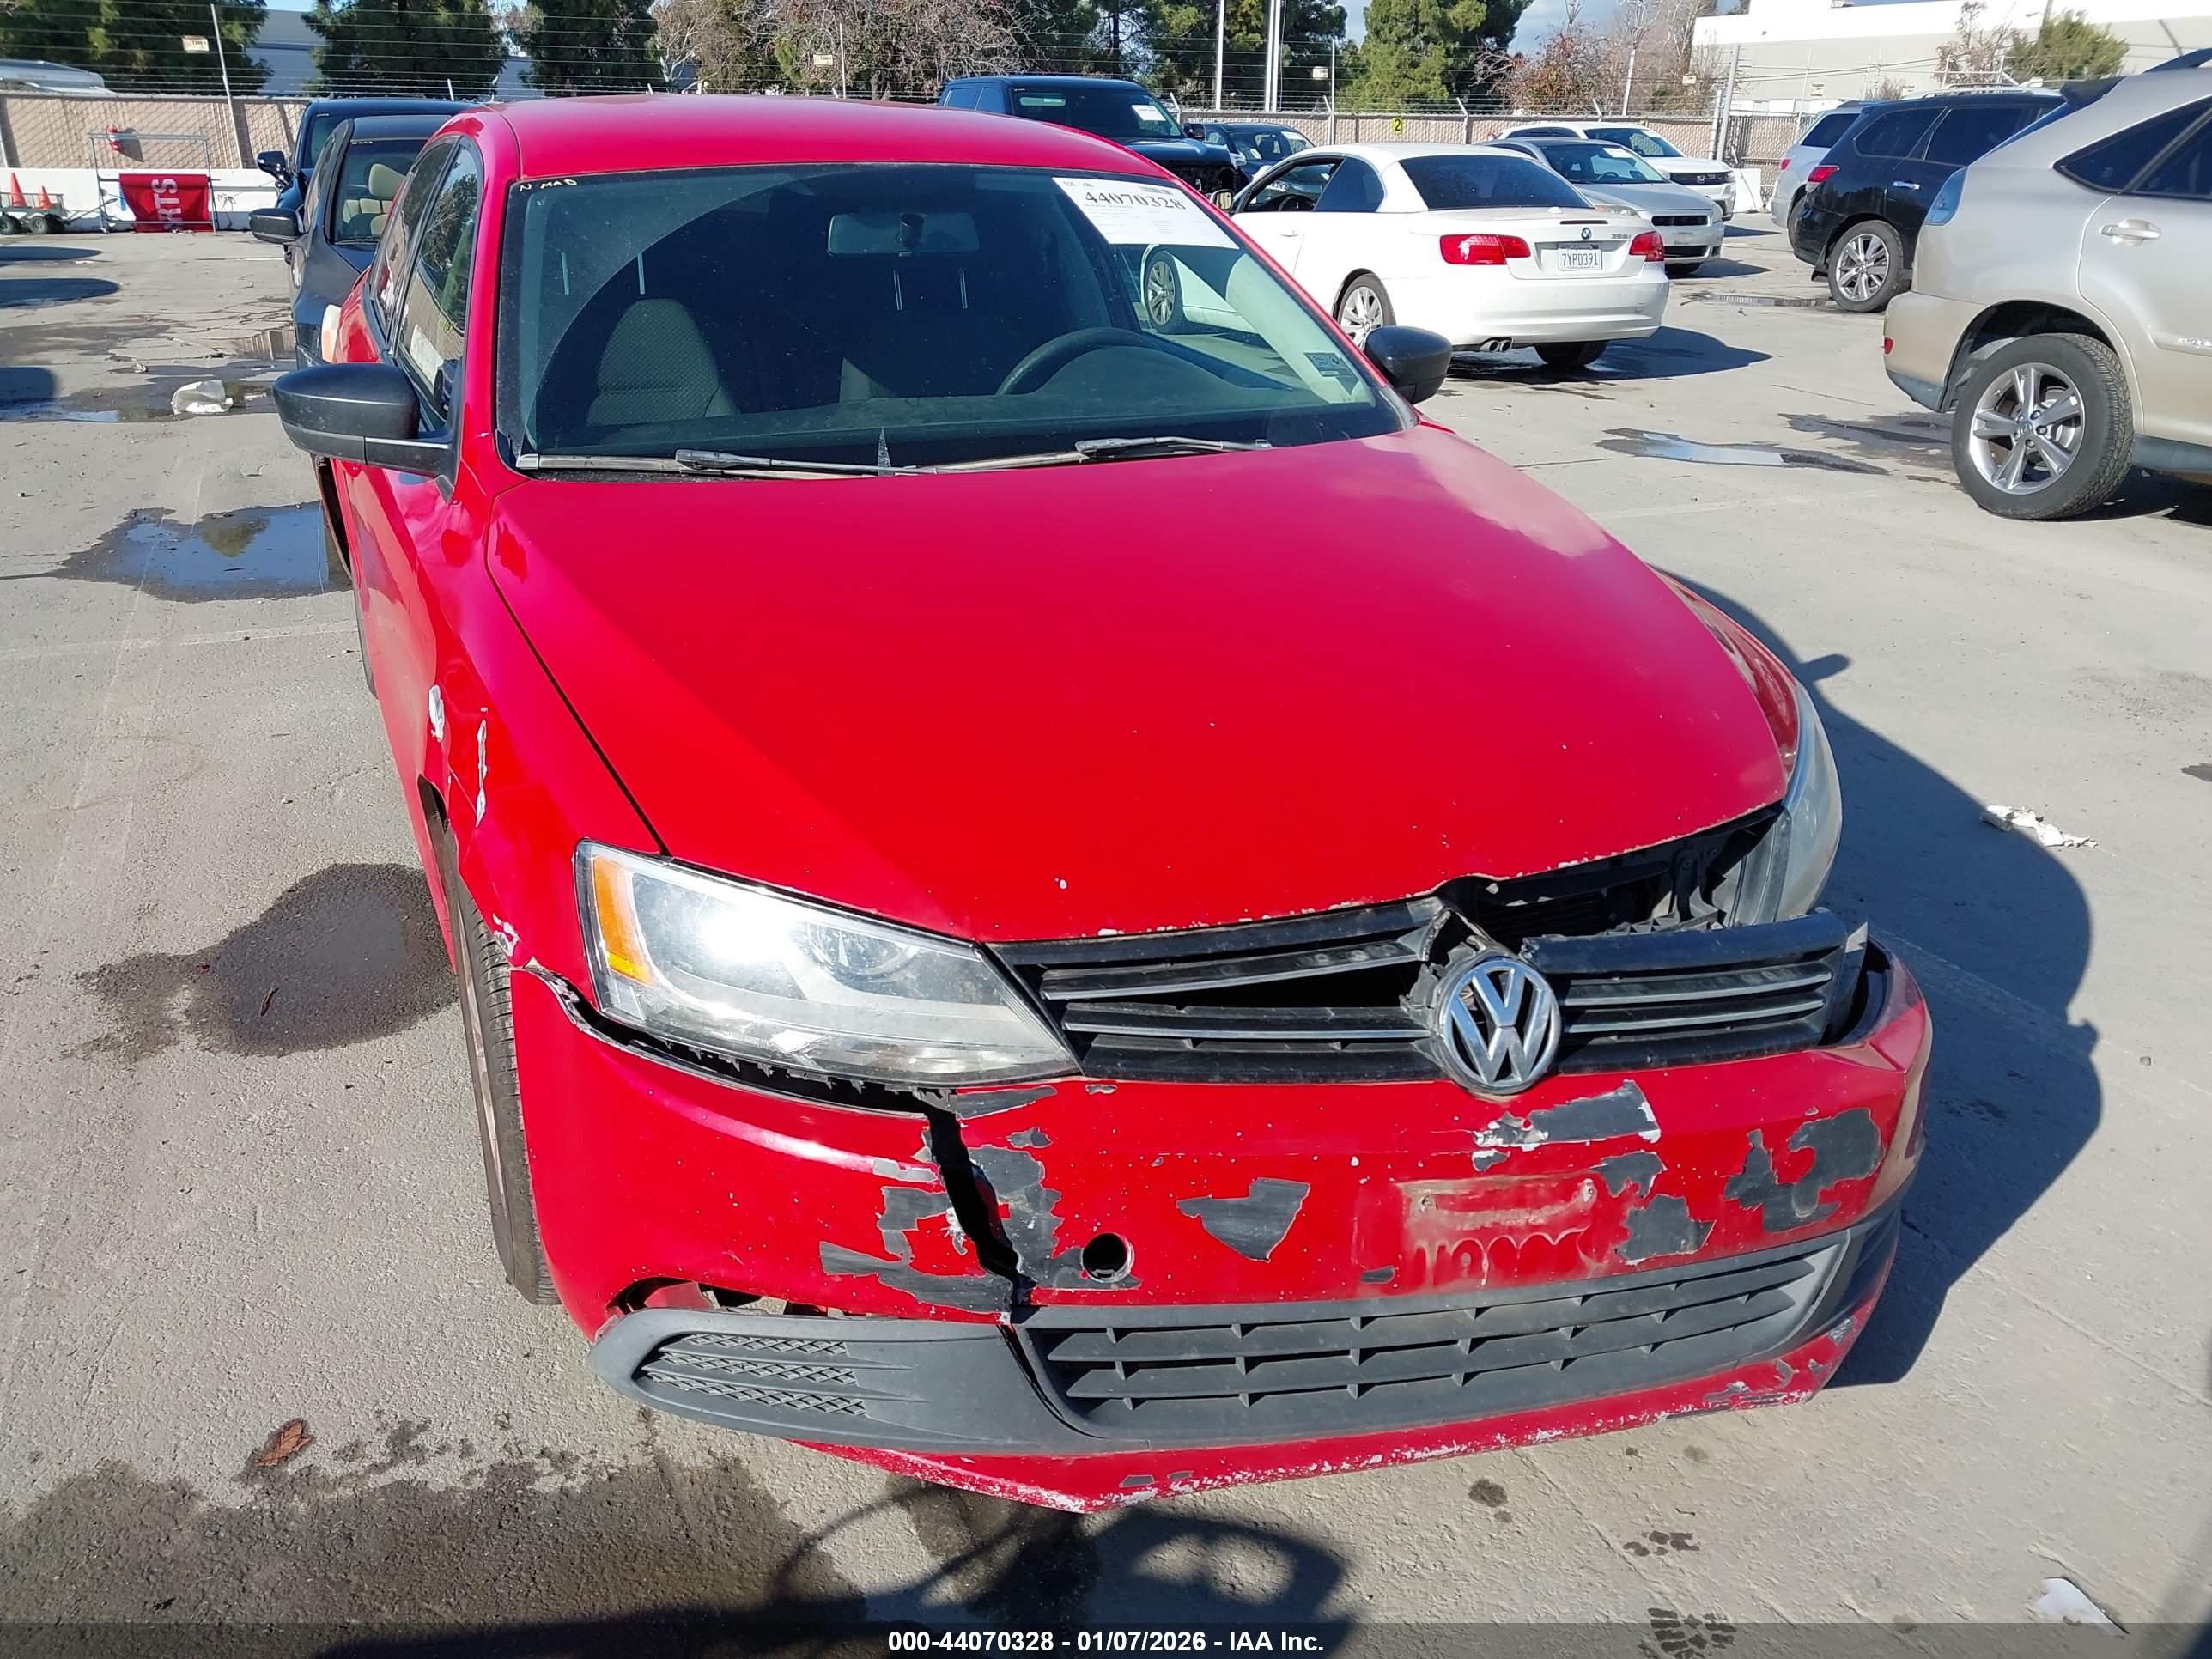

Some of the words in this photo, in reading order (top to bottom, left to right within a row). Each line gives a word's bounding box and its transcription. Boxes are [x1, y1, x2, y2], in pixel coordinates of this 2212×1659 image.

[1394, 118, 1401, 131] 2
[150, 178, 183, 228] RTS
[1085, 191, 1187, 210] 44070328
[1562, 252, 1599, 266] 7YPD391
